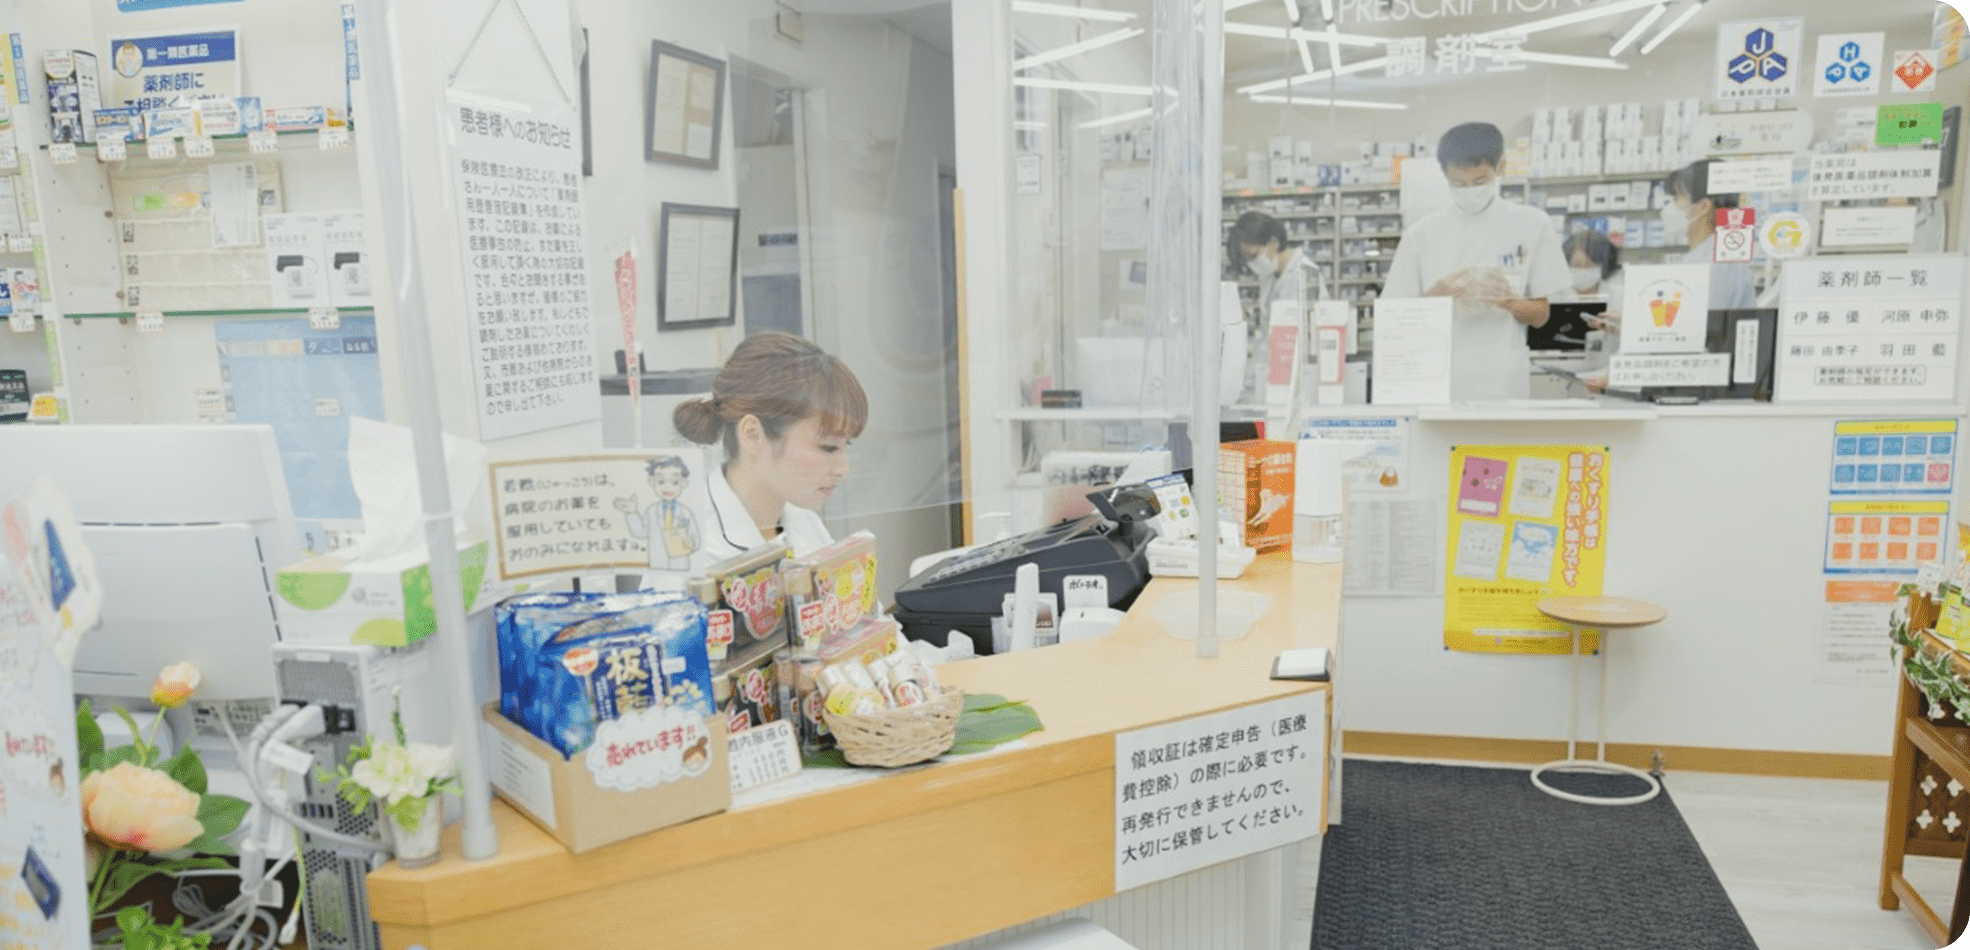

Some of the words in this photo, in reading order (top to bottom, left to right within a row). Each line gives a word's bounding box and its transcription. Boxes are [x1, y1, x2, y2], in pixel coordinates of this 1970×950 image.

[147, 43, 209, 60] 第一類医薬品
[1384, 32, 1529, 78] 調剤室
[143, 72, 205, 93] 薬剤師に
[460, 106, 572, 150] 患者様へのお知らせ
[1813, 168, 1932, 182] 後発医薬品調剤体制加算
[1769, 221, 1803, 248] G
[1817, 269, 1930, 288] 薬剤師一覧
[505, 496, 600, 517] 病院のお薬を
[507, 518, 612, 539] 服用していても
[1121, 778, 1290, 836] 再発行できませんので、
[1121, 803, 1305, 866] 大切に保管してください。
